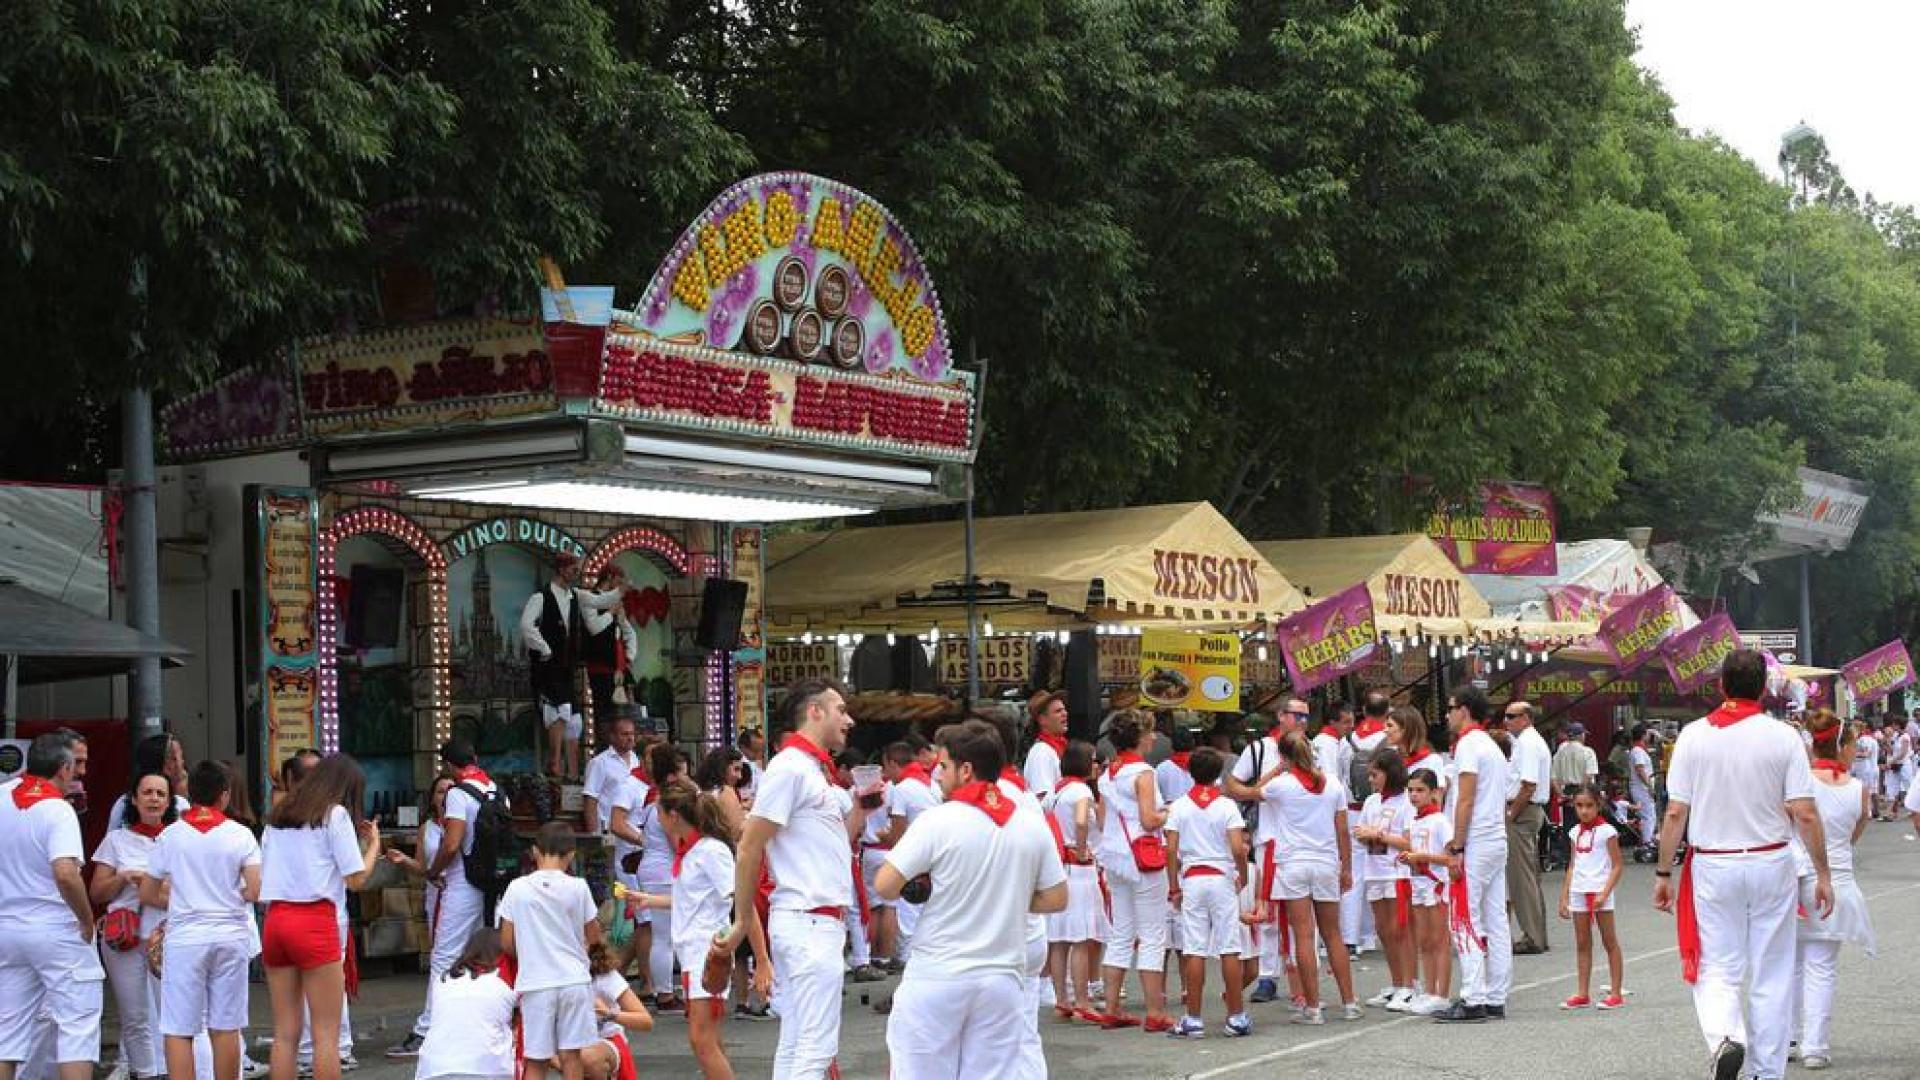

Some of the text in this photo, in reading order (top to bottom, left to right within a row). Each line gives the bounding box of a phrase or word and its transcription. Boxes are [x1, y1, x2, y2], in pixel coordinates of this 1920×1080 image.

[672, 190, 799, 312] VINO
[453, 519, 507, 557] VINO
[1153, 549, 1260, 603] MESON
[1384, 573, 1460, 618] MESON
[946, 641, 1023, 659] POLOS
[1200, 637, 1230, 652] Pollo
[1295, 619, 1371, 672] KEBABS
